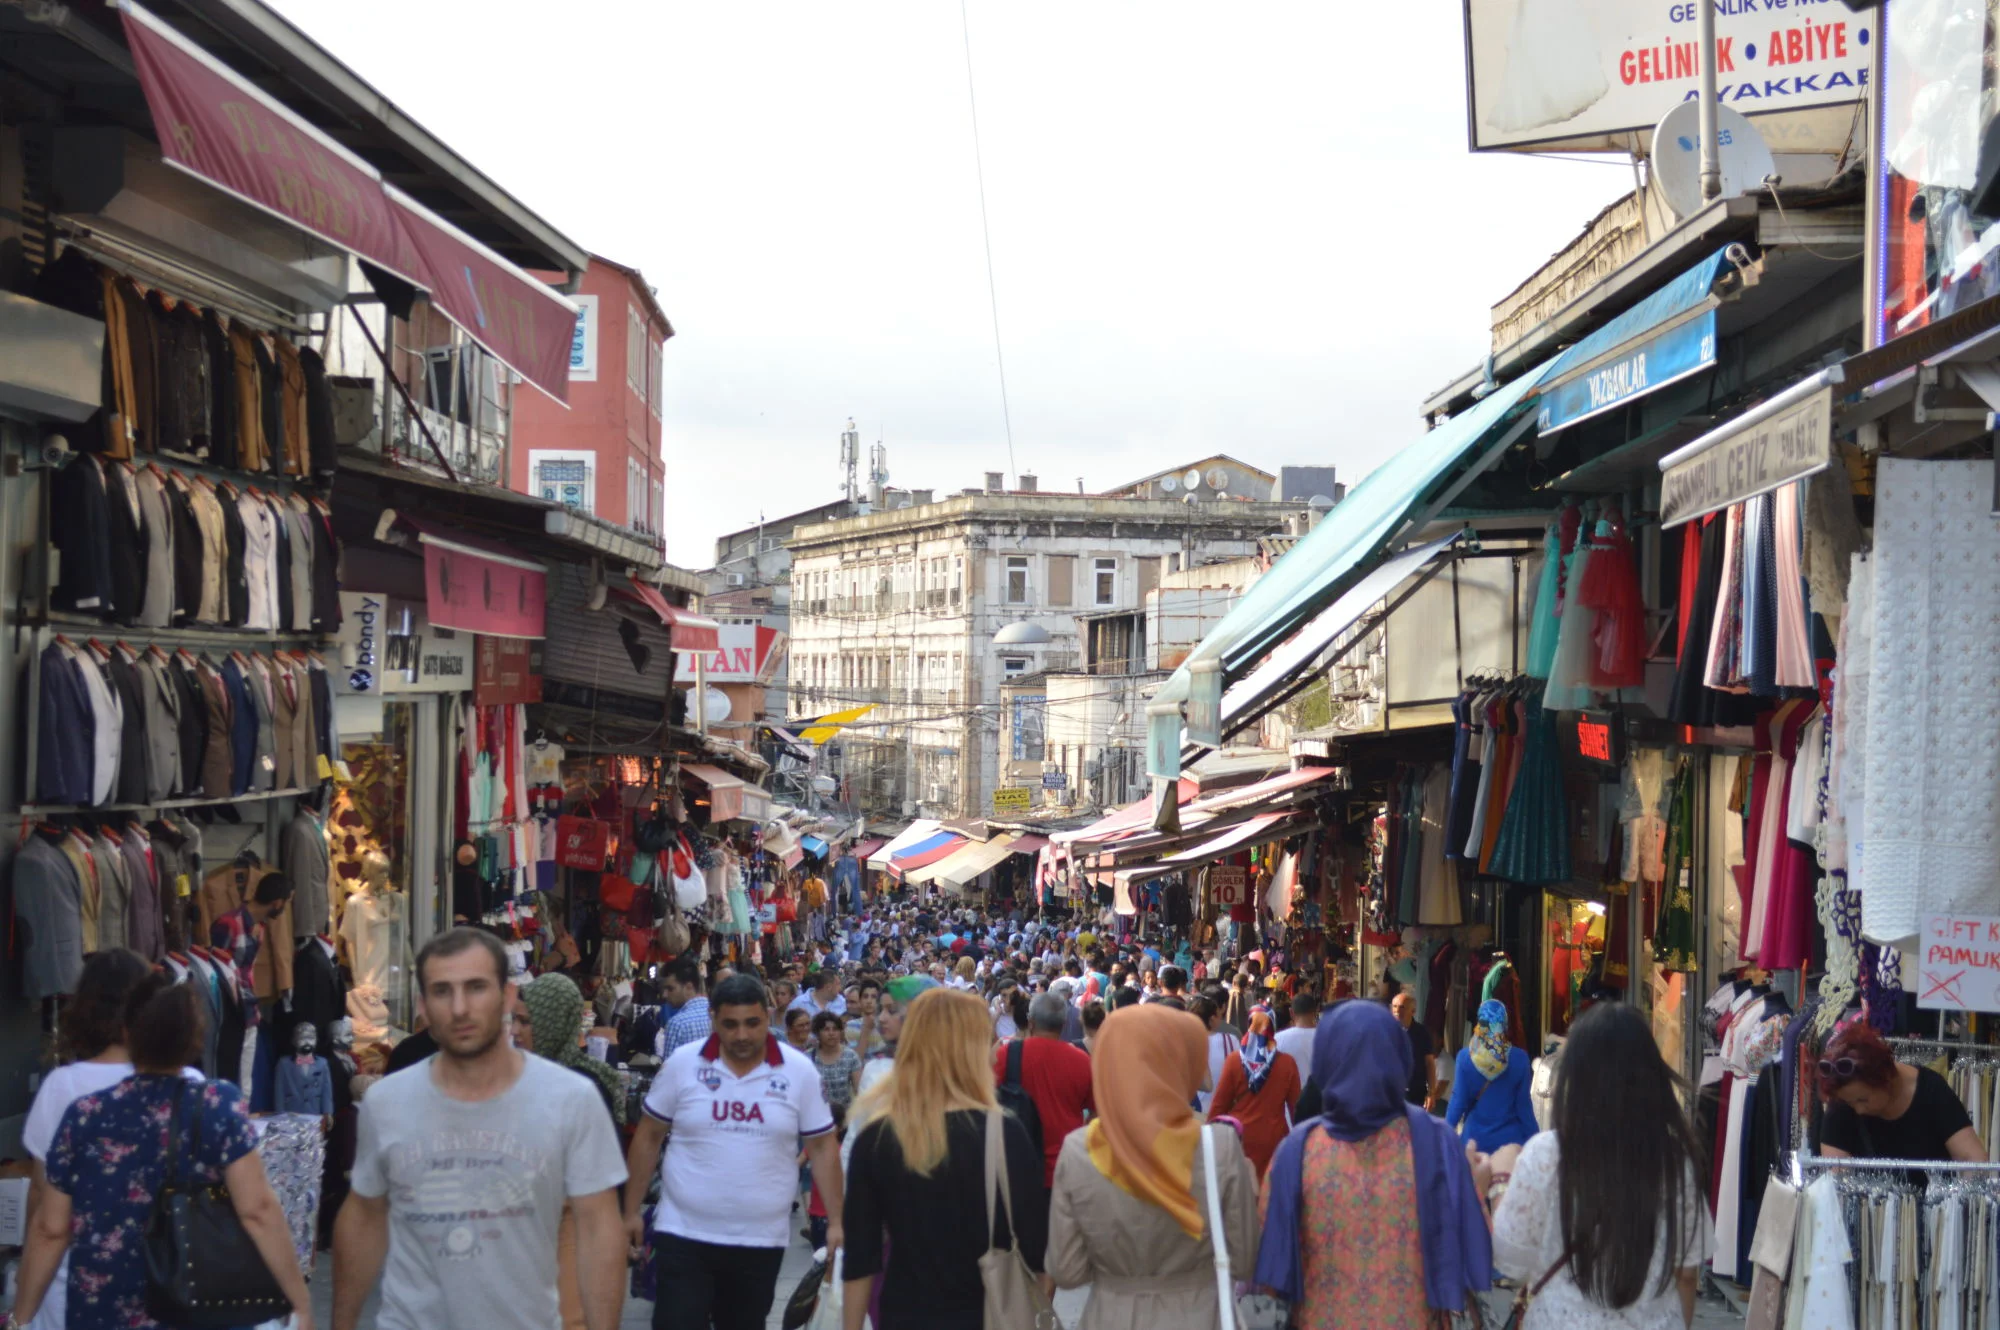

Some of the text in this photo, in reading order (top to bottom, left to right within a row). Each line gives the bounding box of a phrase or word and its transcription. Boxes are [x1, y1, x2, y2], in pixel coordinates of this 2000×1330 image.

[1767, 17, 1848, 67] ABİYE
[1727, 430, 1768, 500] ÇEYİZ
[353, 597, 380, 665] bondy
[1212, 886, 1236, 903] 10
[711, 1100, 764, 1123] USA
